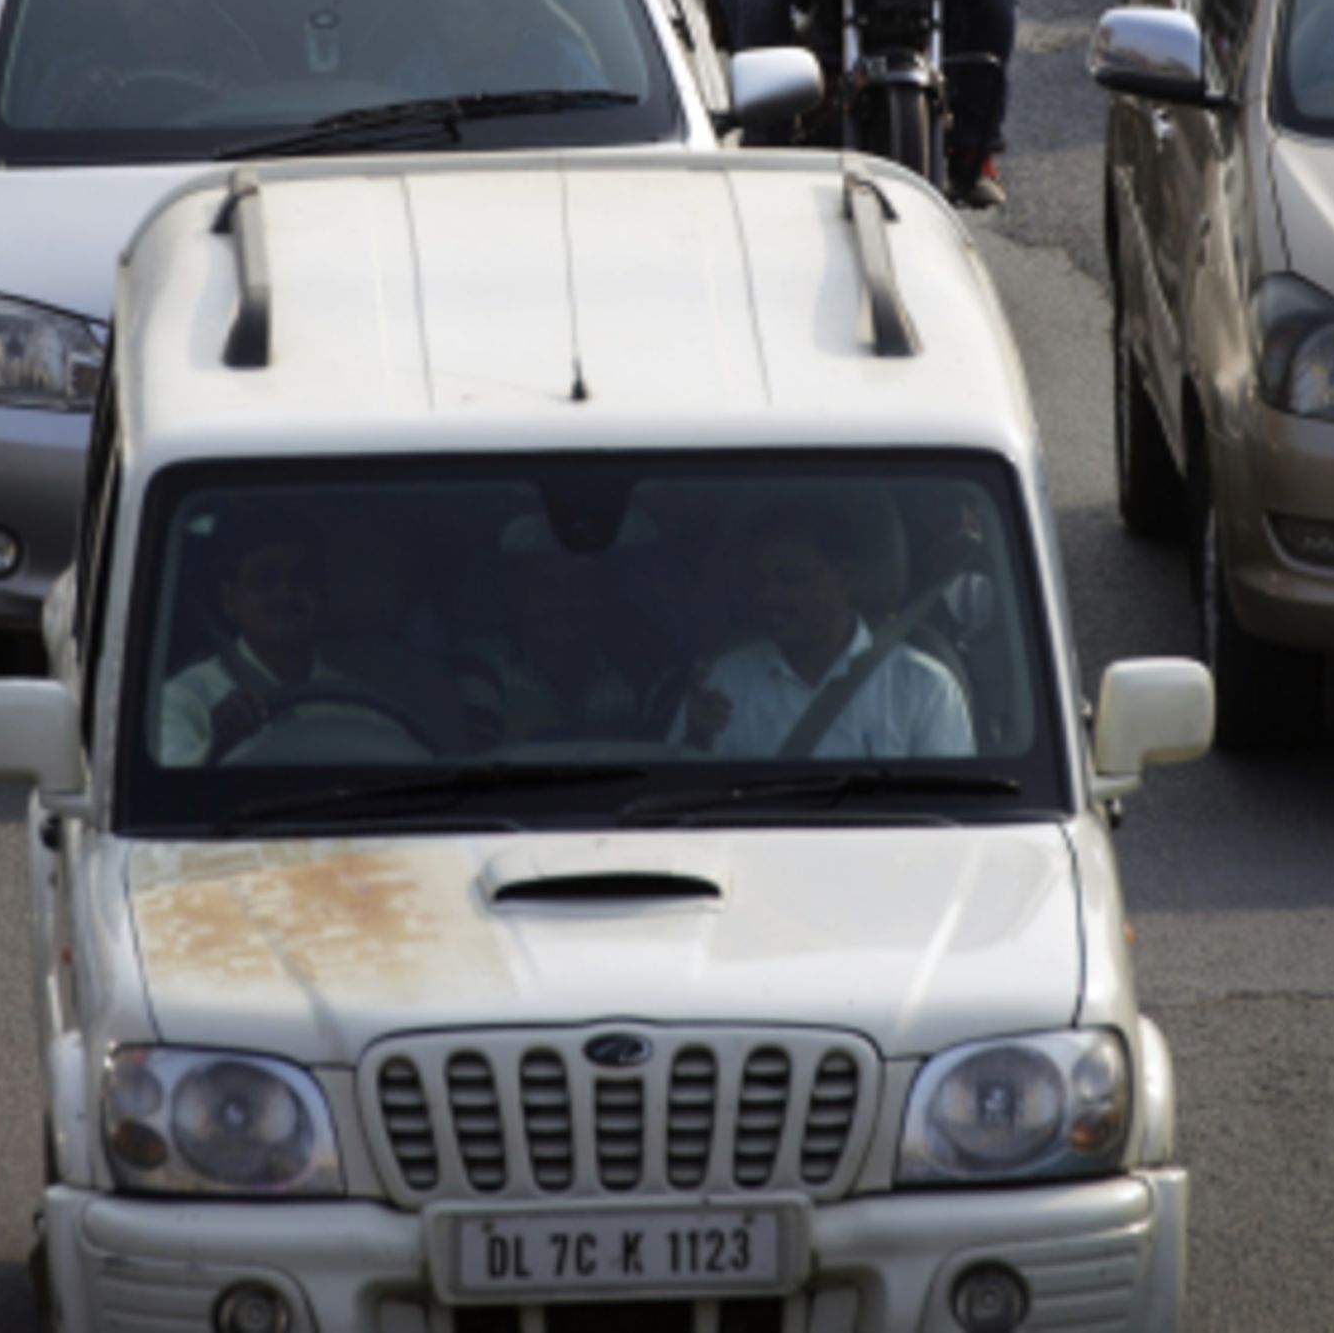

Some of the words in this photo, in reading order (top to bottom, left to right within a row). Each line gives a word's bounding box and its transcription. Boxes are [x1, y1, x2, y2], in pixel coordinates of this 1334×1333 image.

[488, 1235, 531, 1279] DL
[549, 1232, 597, 1277] 7C
[622, 1231, 644, 1275] K
[667, 1227, 750, 1273] 1123
